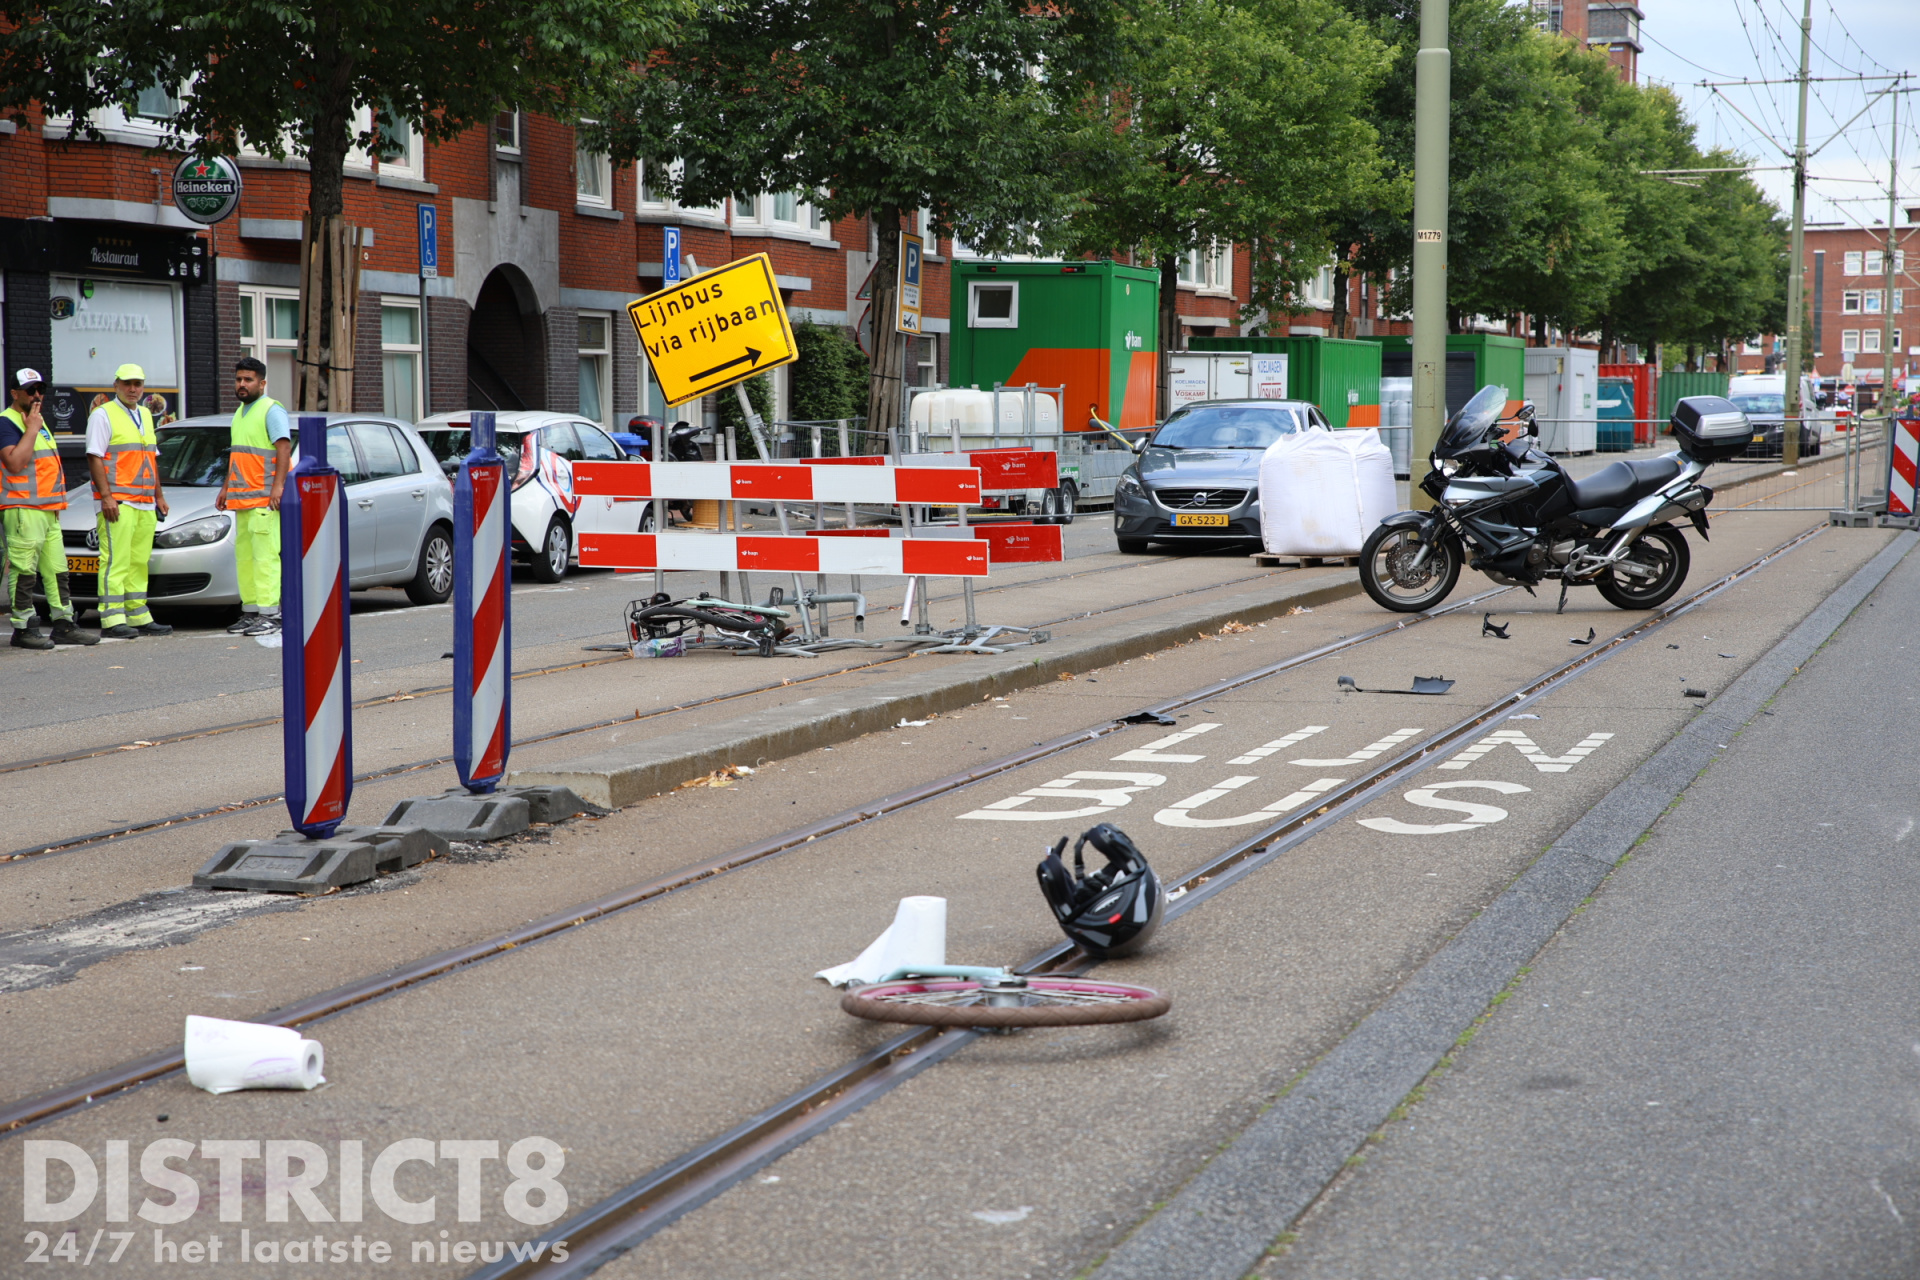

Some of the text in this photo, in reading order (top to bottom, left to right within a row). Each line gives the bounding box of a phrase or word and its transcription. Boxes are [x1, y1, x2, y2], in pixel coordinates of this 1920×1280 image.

[176, 181, 232, 193] Heineken
[424, 210, 433, 240] P
[1417, 231, 1441, 240] M1779
[91, 247, 139, 266] Restaurant
[667, 231, 677, 259] P
[908, 247, 917, 278] P
[634, 282, 724, 329] Lijnbus
[79, 311, 151, 331] CLEOPATRA
[647, 334, 683, 358] via
[689, 299, 775, 343] rijbaan
[1131, 330, 1142, 348] bam
[1180, 515, 1225, 526] GX-523-J
[1110, 722, 1616, 773] LIJN
[955, 770, 1532, 835] BUS
